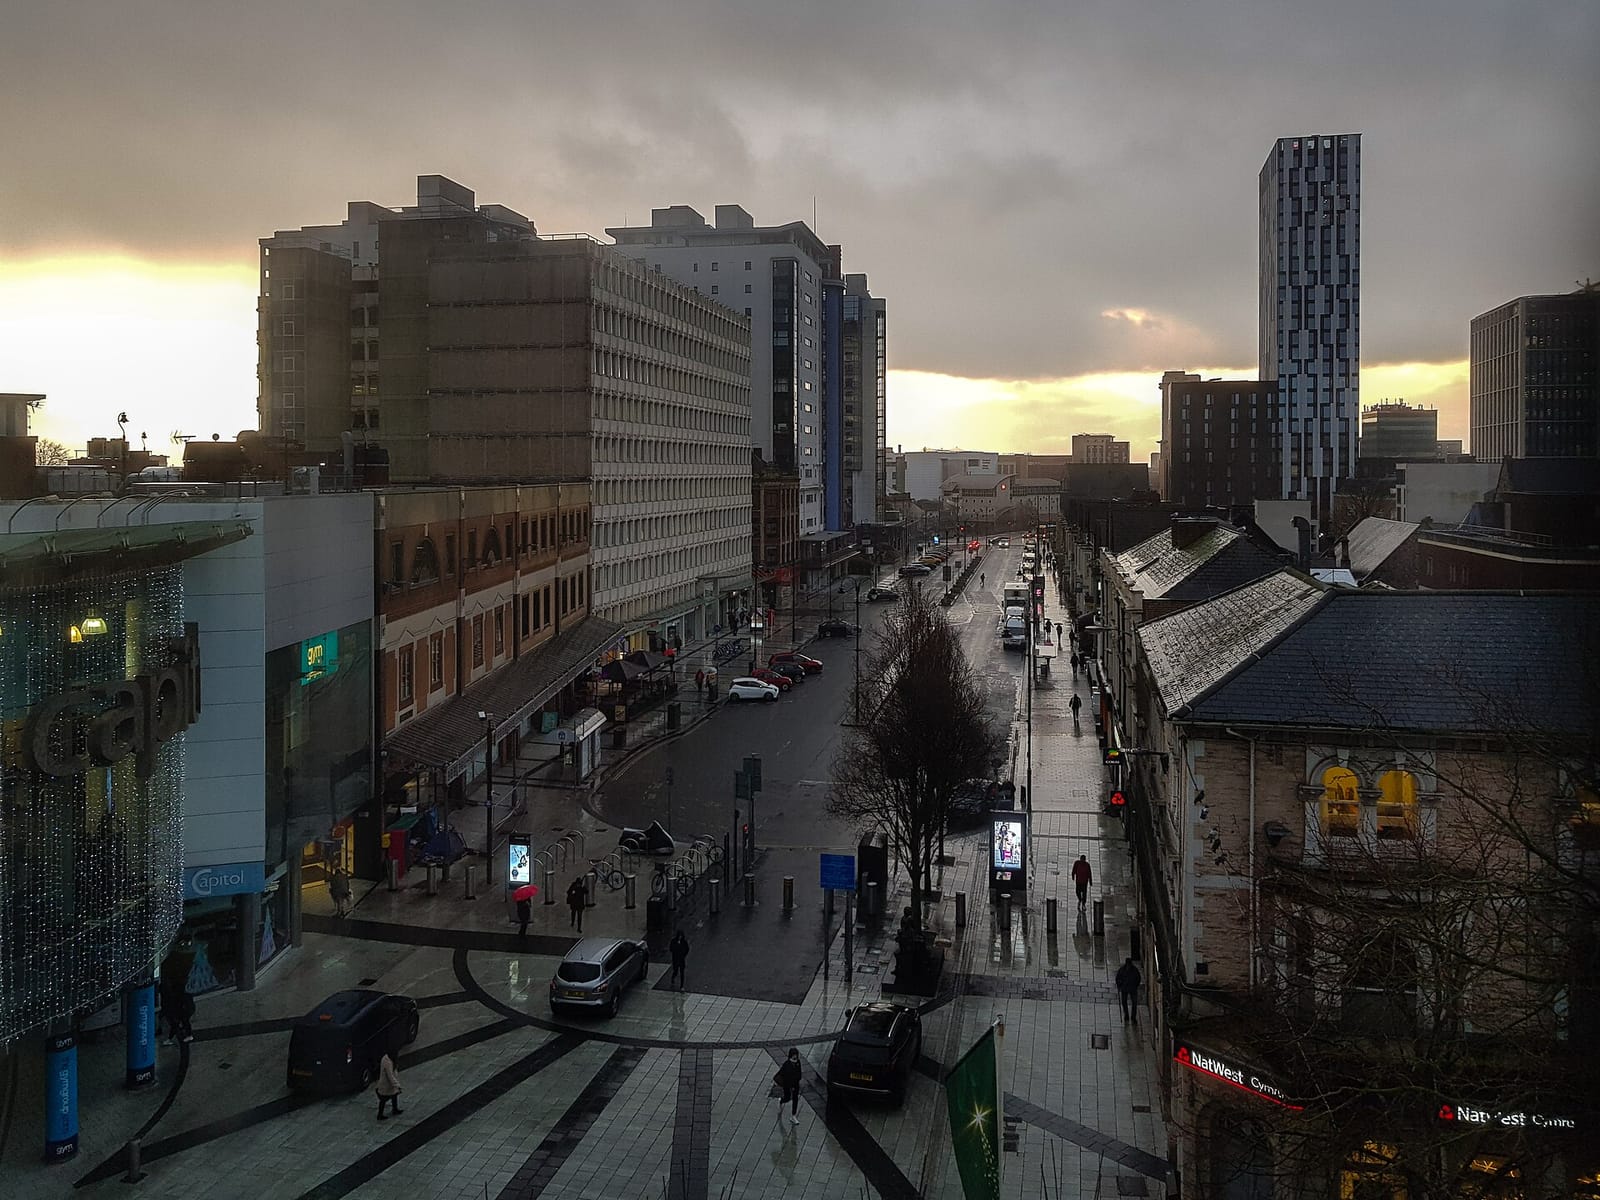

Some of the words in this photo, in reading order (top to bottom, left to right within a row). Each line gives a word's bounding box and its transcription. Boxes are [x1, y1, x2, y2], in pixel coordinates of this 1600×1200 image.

[307, 644, 323, 665] gym
[192, 868, 244, 896] Capitol
[1191, 1050, 1244, 1085] NatWest
